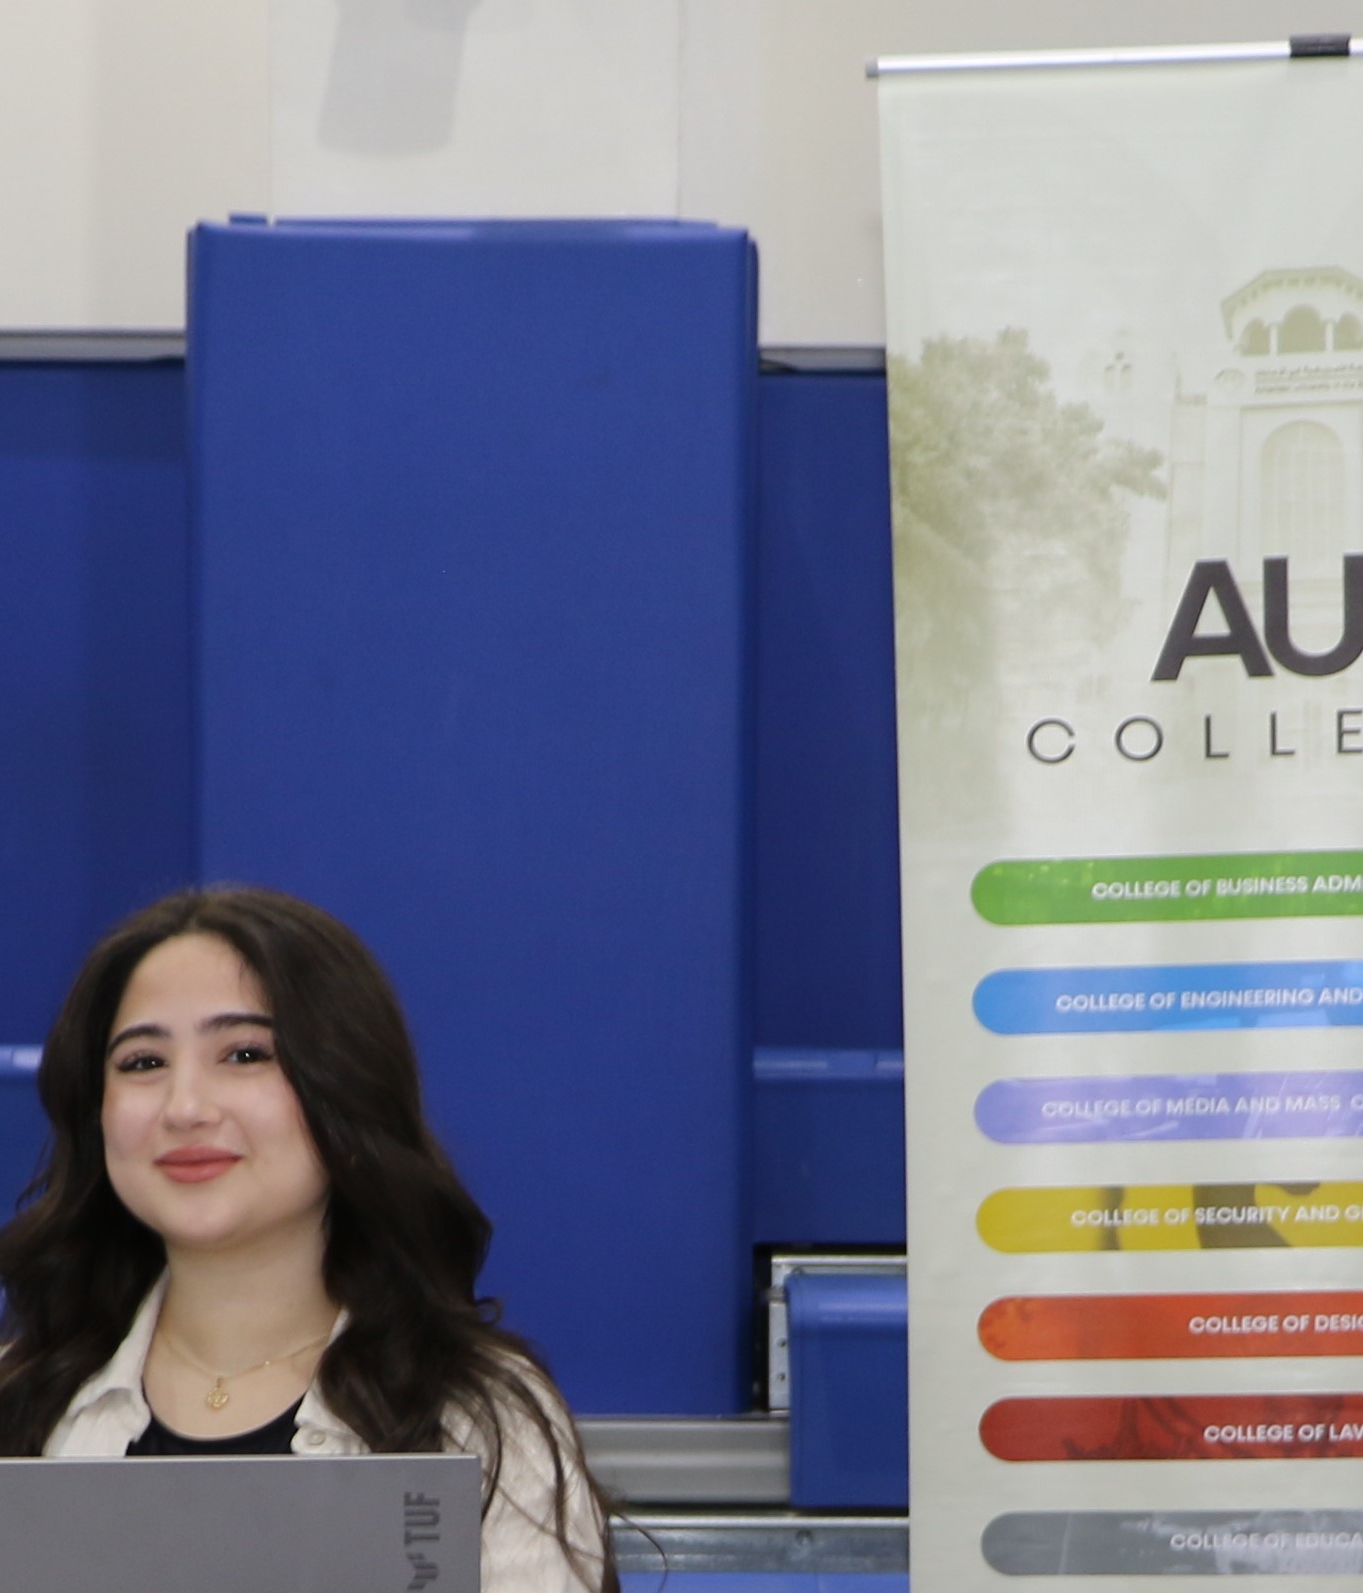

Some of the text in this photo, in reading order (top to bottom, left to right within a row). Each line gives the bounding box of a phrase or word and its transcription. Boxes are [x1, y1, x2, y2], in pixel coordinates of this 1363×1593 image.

[1091, 880, 1180, 900] COLLEGE
[1185, 879, 1212, 898] OF
[1216, 876, 1308, 897] BUSINESS
[1055, 992, 1145, 1012] COLLEGE
[1149, 991, 1176, 1009] OF
[1180, 987, 1315, 1009] ENGINEERING
[1319, 985, 1363, 1005] AND
[1042, 1099, 1131, 1118] COLLEGE
[1135, 1097, 1162, 1116] OF
[1166, 1095, 1230, 1114] MEDIA
[1234, 1095, 1281, 1114] AND
[1285, 1094, 1341, 1113] MASS
[1070, 1207, 1160, 1227] COLLEGE
[1163, 1206, 1192, 1225] OF
[1194, 1205, 1289, 1225] SECURITY
[1294, 1203, 1340, 1222] AND
[1188, 1316, 1278, 1336] COLLEGE
[1282, 1314, 1310, 1333] OF
[1203, 1424, 1293, 1443] COLLEGE
[1297, 1422, 1325, 1441] OF
[403, 1491, 440, 1546] TUF
[1170, 1531, 1260, 1551] COLLEGE
[1264, 1531, 1291, 1549] OF
